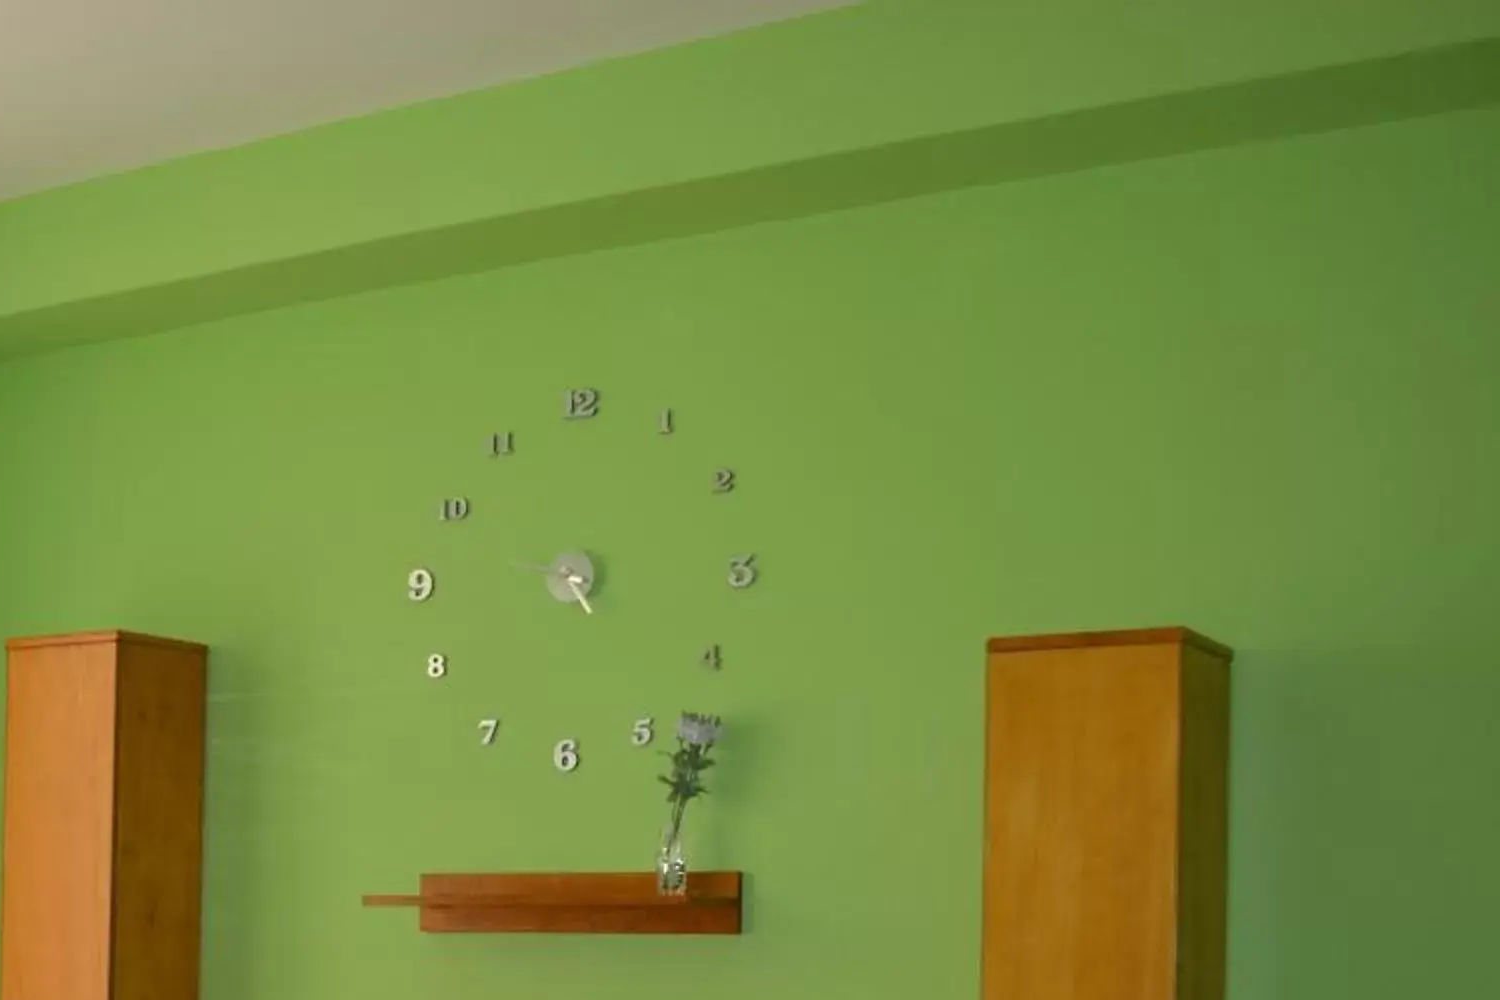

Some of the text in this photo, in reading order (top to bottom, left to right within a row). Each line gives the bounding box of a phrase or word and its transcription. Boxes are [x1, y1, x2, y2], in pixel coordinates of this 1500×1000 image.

[565, 389, 598, 418] 12
[659, 410, 673, 434] 1
[489, 433, 514, 457] 11
[713, 469, 734, 493] 2
[440, 497, 470, 521] 10
[728, 555, 756, 588] 3
[408, 569, 434, 601] 9
[428, 654, 446, 678] 8
[702, 645, 721, 671] 4
[478, 720, 499, 746] 7
[632, 719, 653, 746] 5
[554, 740, 579, 771] 6
